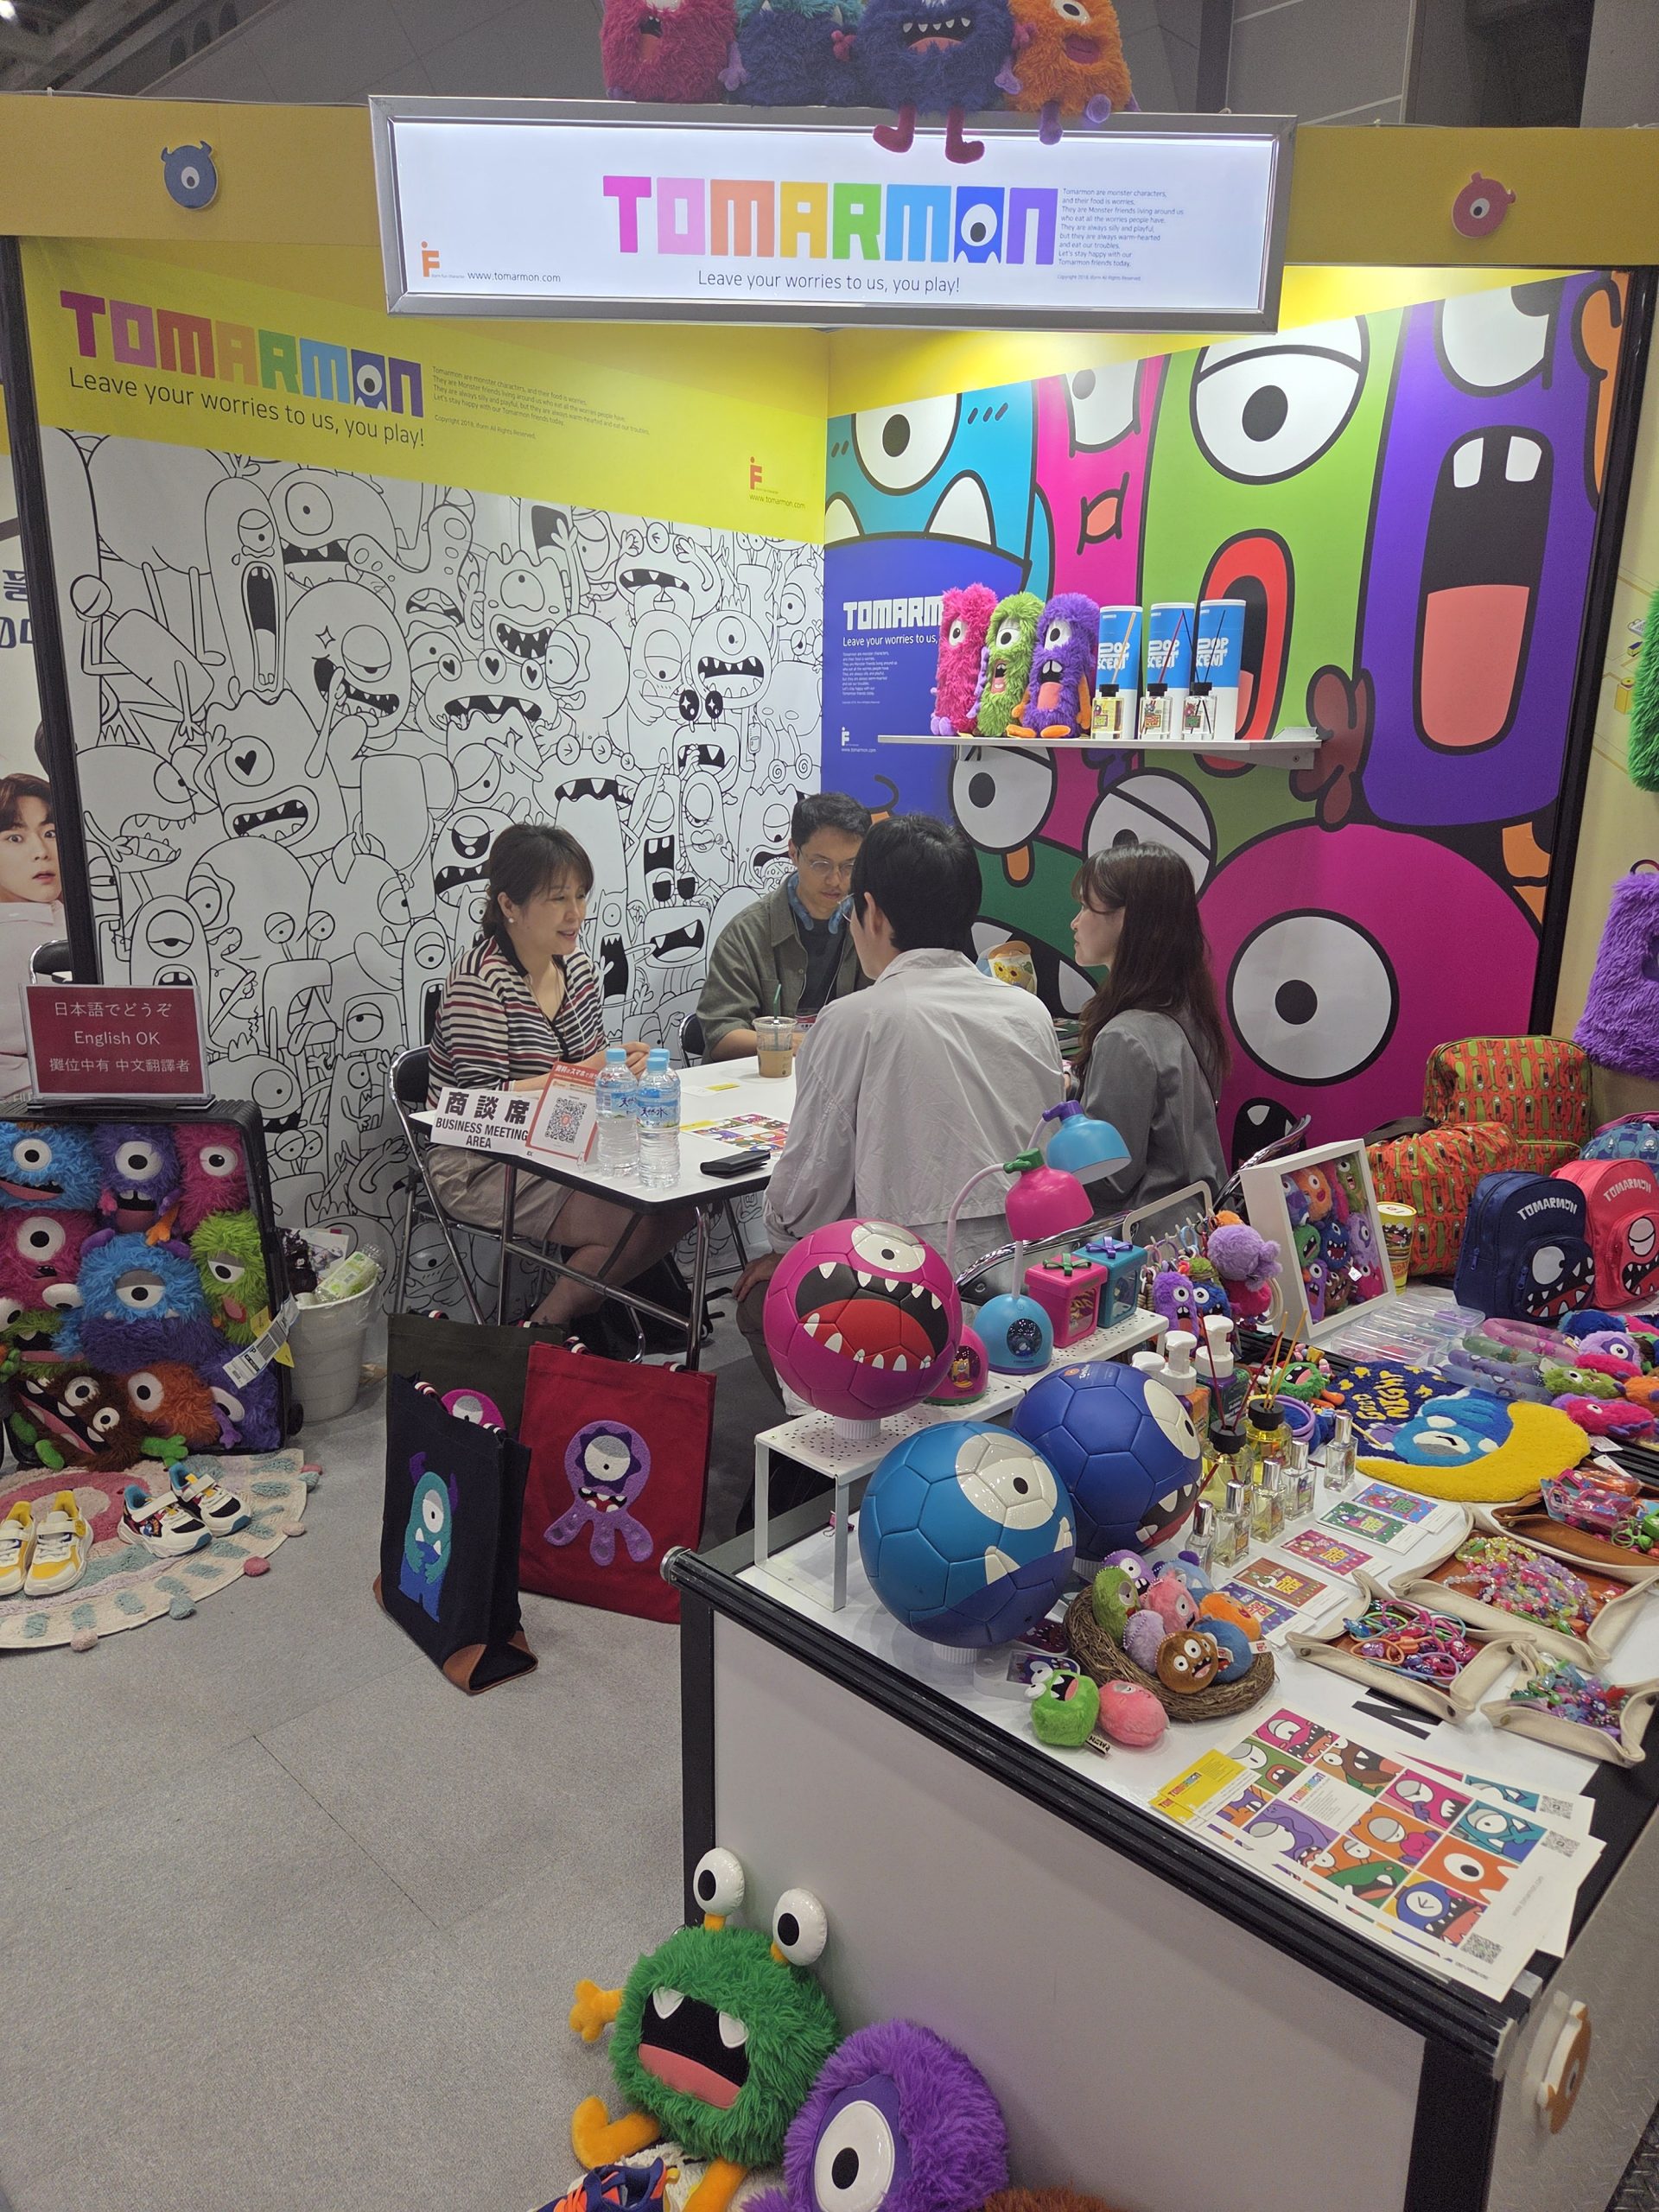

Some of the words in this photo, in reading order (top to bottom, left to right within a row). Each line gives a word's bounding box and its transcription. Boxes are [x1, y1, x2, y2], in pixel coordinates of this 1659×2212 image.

[603, 175, 1058, 265] TOMARMON
[467, 272, 561, 283] www.tomarmon.com
[698, 270, 742, 286] Leave
[747, 273, 781, 290] your
[785, 274, 842, 289] worries
[846, 274, 862, 290] to
[867, 277, 888, 293] us,
[893, 278, 920, 294] you
[925, 276, 960, 296] play!
[60, 290, 424, 418] TOMARMON
[69, 366, 137, 397] Leave
[144, 382, 194, 407] your
[201, 393, 279, 421] worries
[285, 405, 305, 426] to
[312, 414, 339, 435] us,
[345, 418, 378, 439] you
[384, 422, 425, 449] play!
[843, 595, 944, 630] TOMARM
[843, 636, 864, 647] Leave
[866, 636, 883, 648] your
[885, 634, 914, 645] worries
[915, 634, 924, 644] to
[926, 635, 939, 644] us,
[55, 1001, 172, 1017] 日本語でどうぞ
[75, 1031, 130, 1047] English
[136, 1032, 161, 1045] OK
[49, 1058, 110, 1072] 攤位中有
[116, 1058, 191, 1072] 中文翻譯者
[445, 1092, 530, 1125] 商談席
[619, 1097, 637, 1107] 天然
[435, 1118, 483, 1134] BUSINESS
[484, 1125, 528, 1141] MEETING
[466, 1135, 491, 1149] AREA
